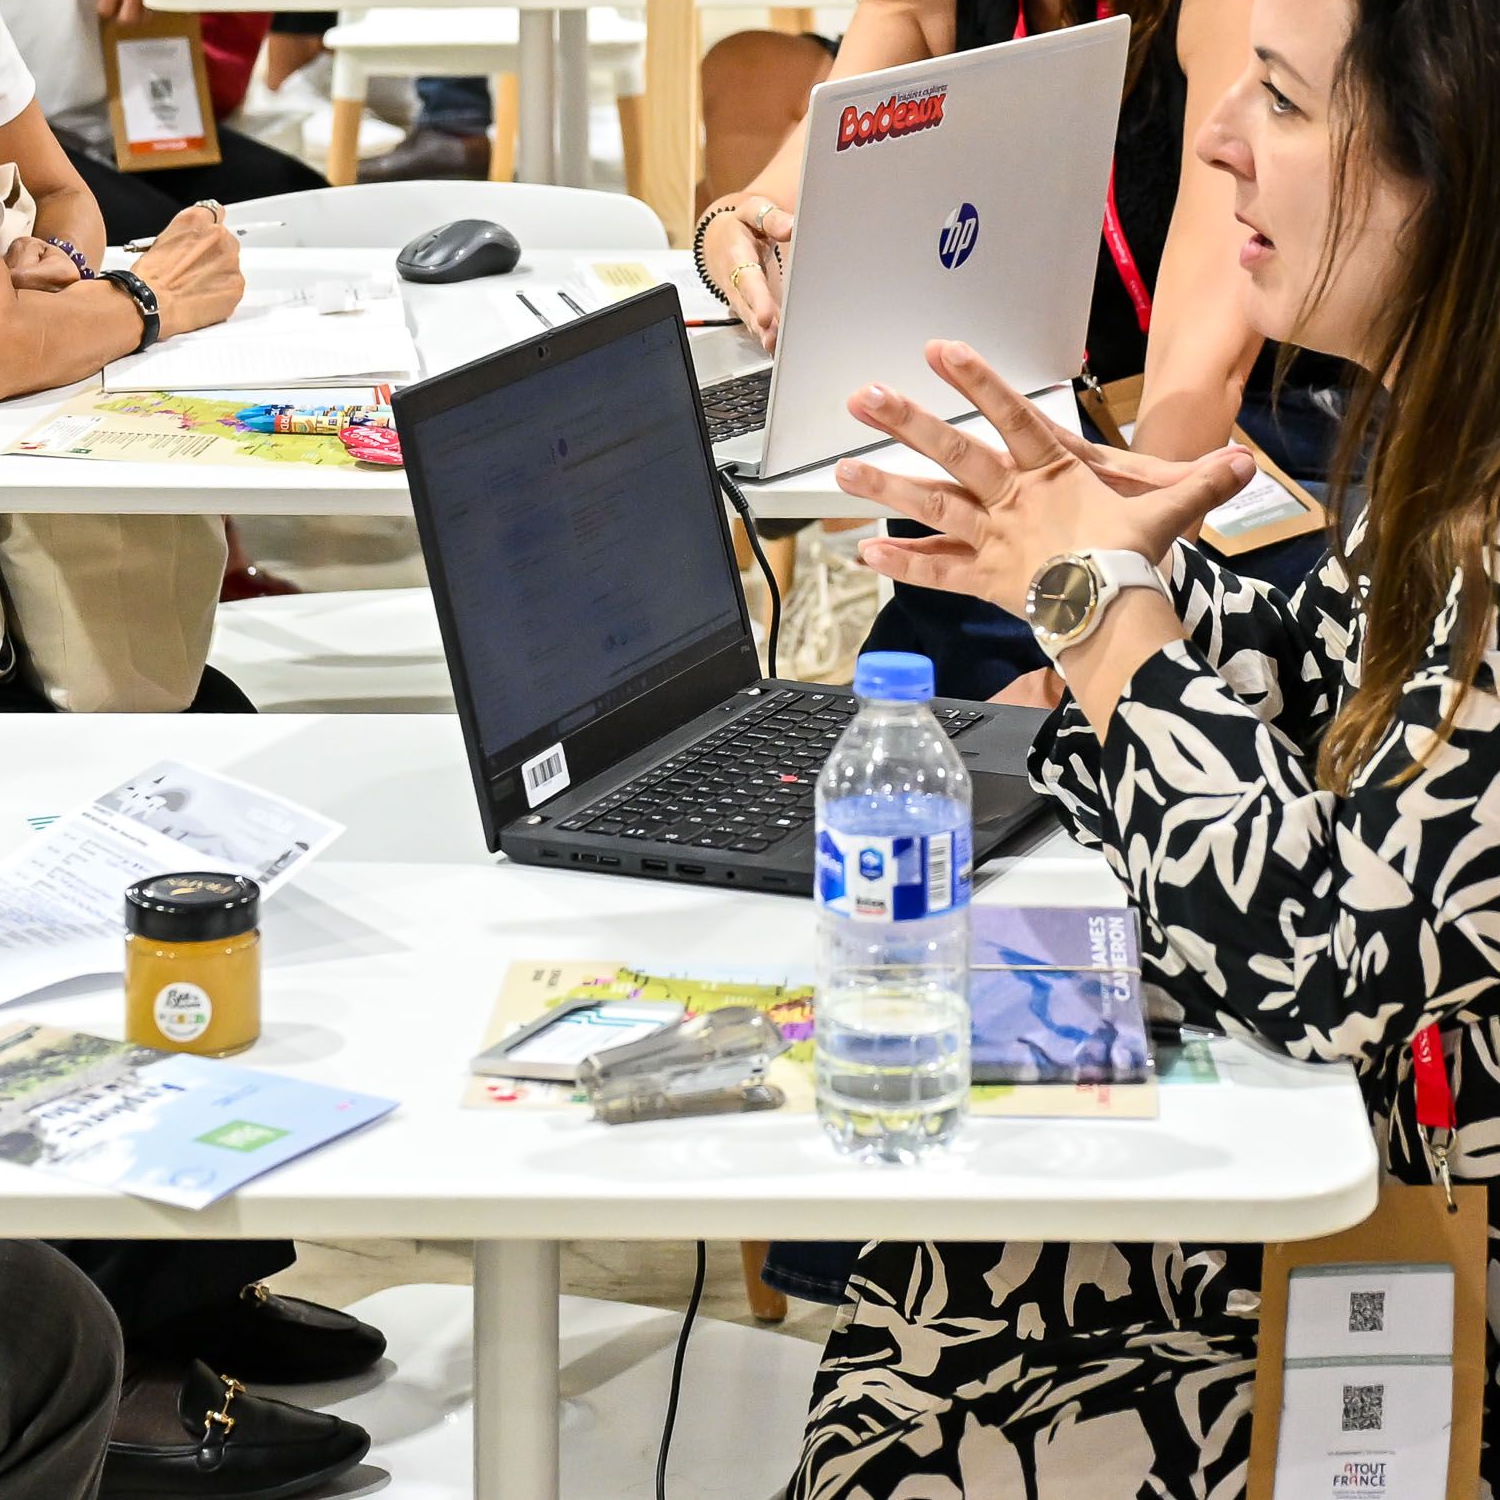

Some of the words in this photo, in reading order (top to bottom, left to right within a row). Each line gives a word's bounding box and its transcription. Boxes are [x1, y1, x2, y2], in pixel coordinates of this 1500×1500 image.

[837, 93, 946, 151] Bordeaux
[939, 203, 979, 269] hp
[1333, 1475, 1386, 1487] FRANCE
[1344, 1463, 1387, 1475] ATOUT
